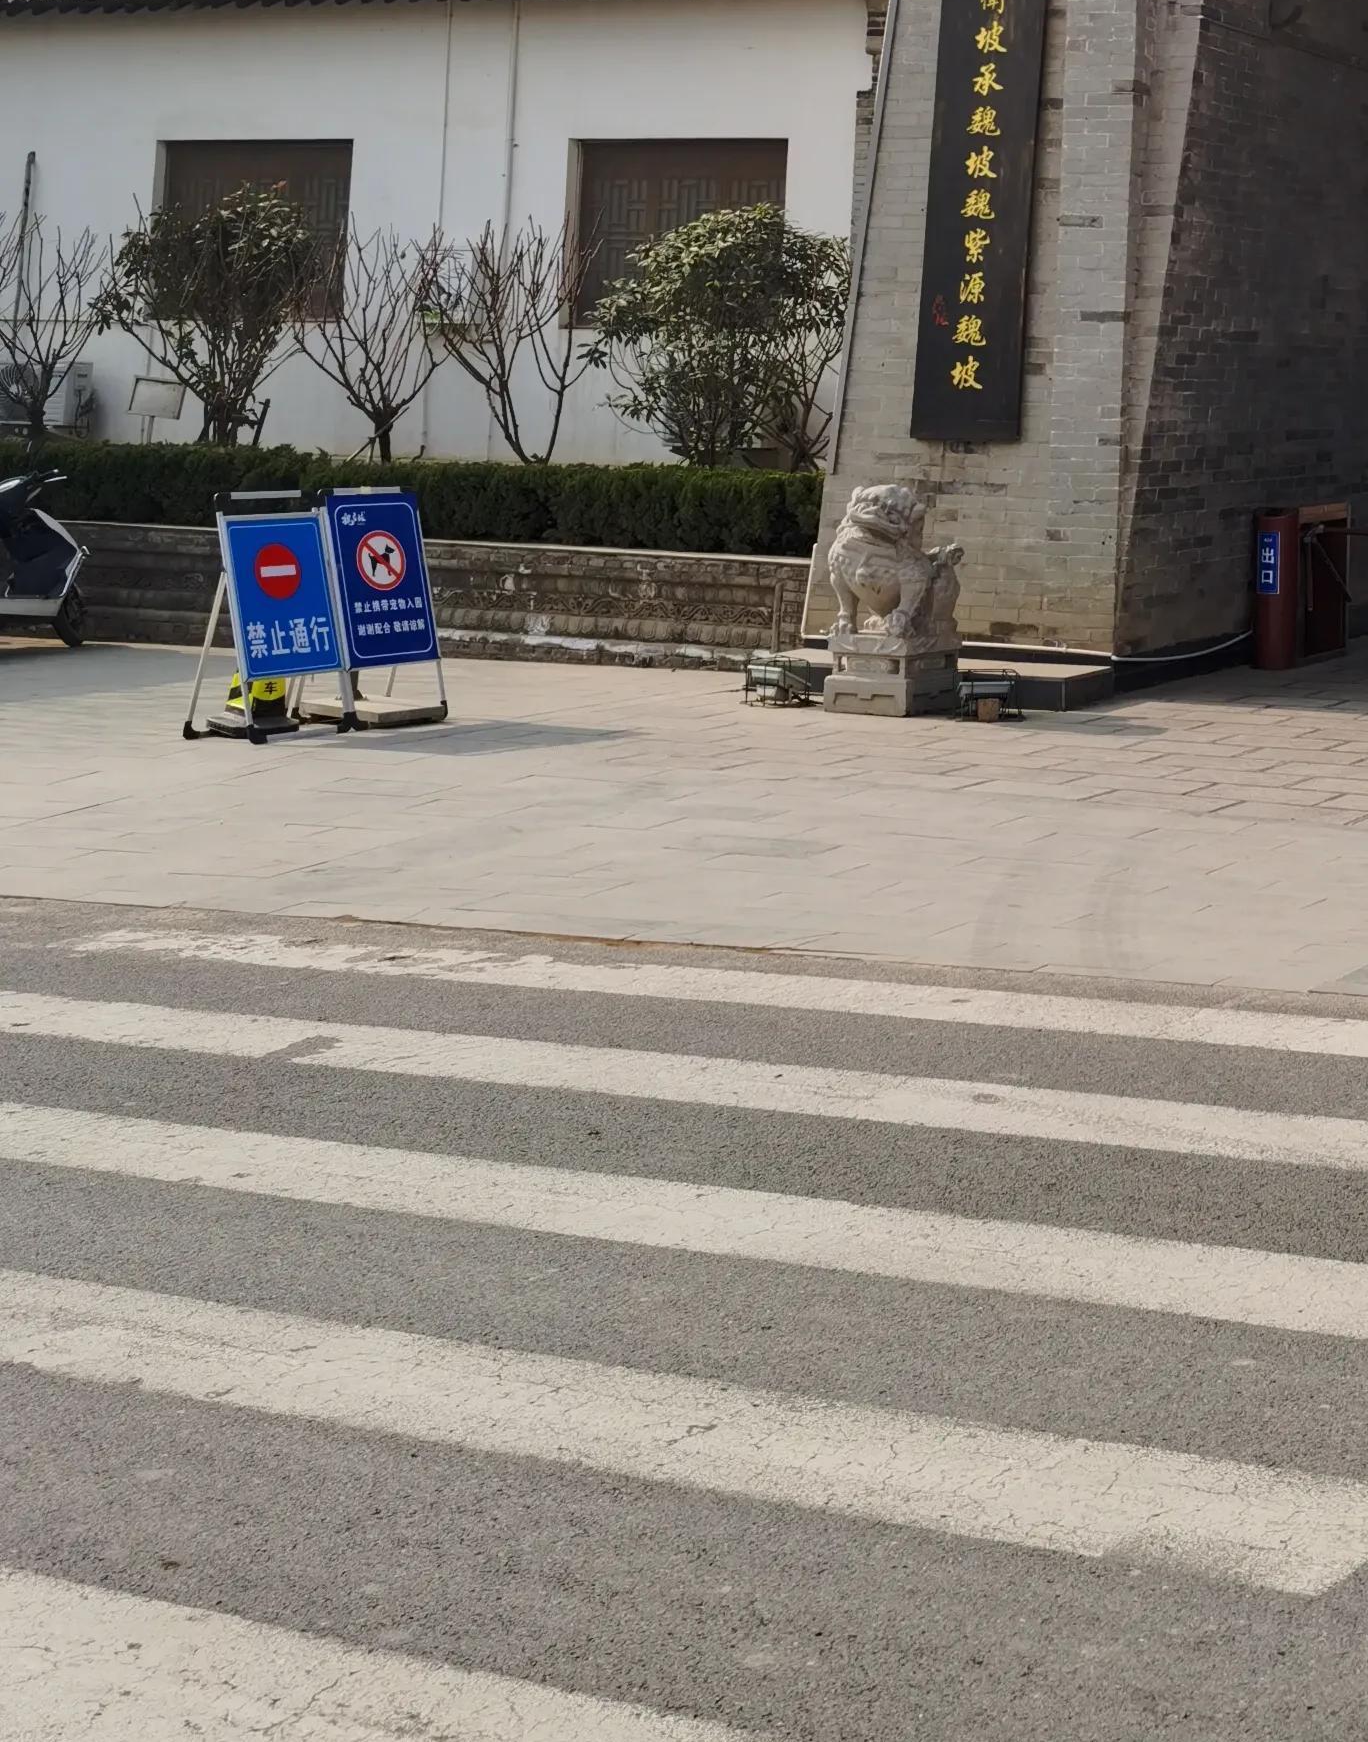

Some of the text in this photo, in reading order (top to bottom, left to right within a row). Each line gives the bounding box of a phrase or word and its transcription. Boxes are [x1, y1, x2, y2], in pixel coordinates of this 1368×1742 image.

[1261, 547, 1275, 584] 出口
[247, 615, 330, 659] 禁止通行
[264, 681, 277, 695] 车
